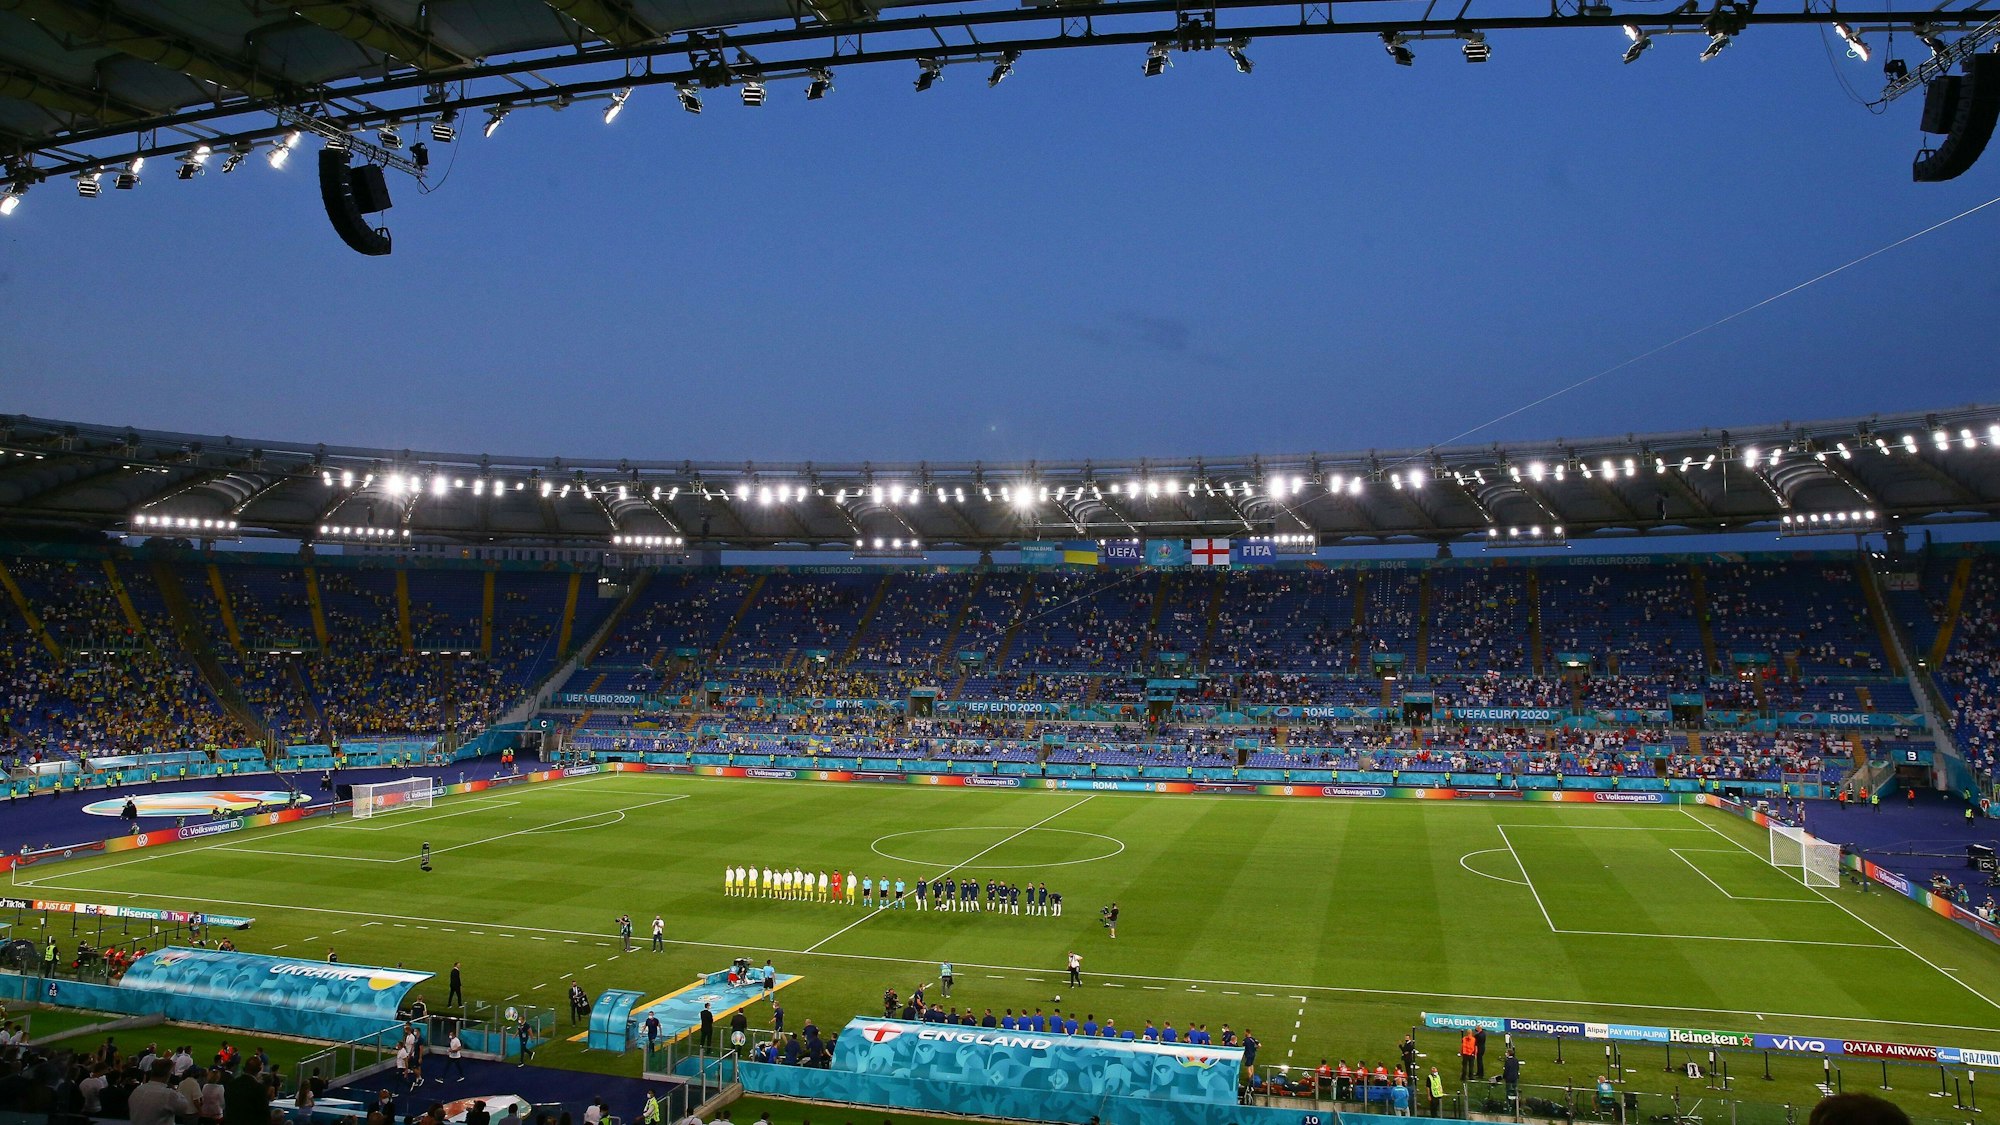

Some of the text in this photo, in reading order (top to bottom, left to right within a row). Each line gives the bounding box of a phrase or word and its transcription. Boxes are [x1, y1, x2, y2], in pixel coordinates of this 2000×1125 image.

[1108, 547, 1137, 557] UEFA
[1243, 545, 1271, 556] FIFA
[1569, 556, 1650, 565] UEFA EURO 2020
[566, 694, 636, 703] UEFA EURO 2020
[1017, 704, 1042, 712] 2020
[1303, 708, 1334, 717] ROME
[1458, 709, 1549, 720] UEFA EURO 2020
[1830, 714, 1869, 724] ROME
[1908, 751, 1917, 760] B
[754, 769, 784, 777] Volkswagen
[973, 778, 1006, 786] Volkswagen
[1092, 781, 1118, 789] ROMA
[1332, 788, 1371, 796] Volkswagen
[1606, 793, 1647, 802] Volkswagen
[190, 820, 239, 835] Volkswagen ID.
[6, 900, 26, 909] TikTok
[44, 902, 71, 911] JUST EAT
[85, 905, 107, 915] FedEx
[119, 907, 158, 919] Hisense
[170, 912, 184, 921] The
[269, 963, 362, 981] UKRAINE
[1432, 1017, 1498, 1028] UEFA EURO 2020
[1510, 1019, 1580, 1033] Booking.com
[1586, 1026, 1608, 1035] Alipay
[1642, 1031, 1667, 1039] ALIPAY
[917, 1029, 1052, 1049] ENGLAND
[1669, 1029, 1738, 1046] Heineken
[1772, 1036, 1825, 1052] vivo
[1843, 1041, 1883, 1054] QATAR
[1886, 1044, 1937, 1058] AIRWAYS
[1962, 1051, 2000, 1065] GAZPRO
[1305, 1116, 1318, 1124] 10
